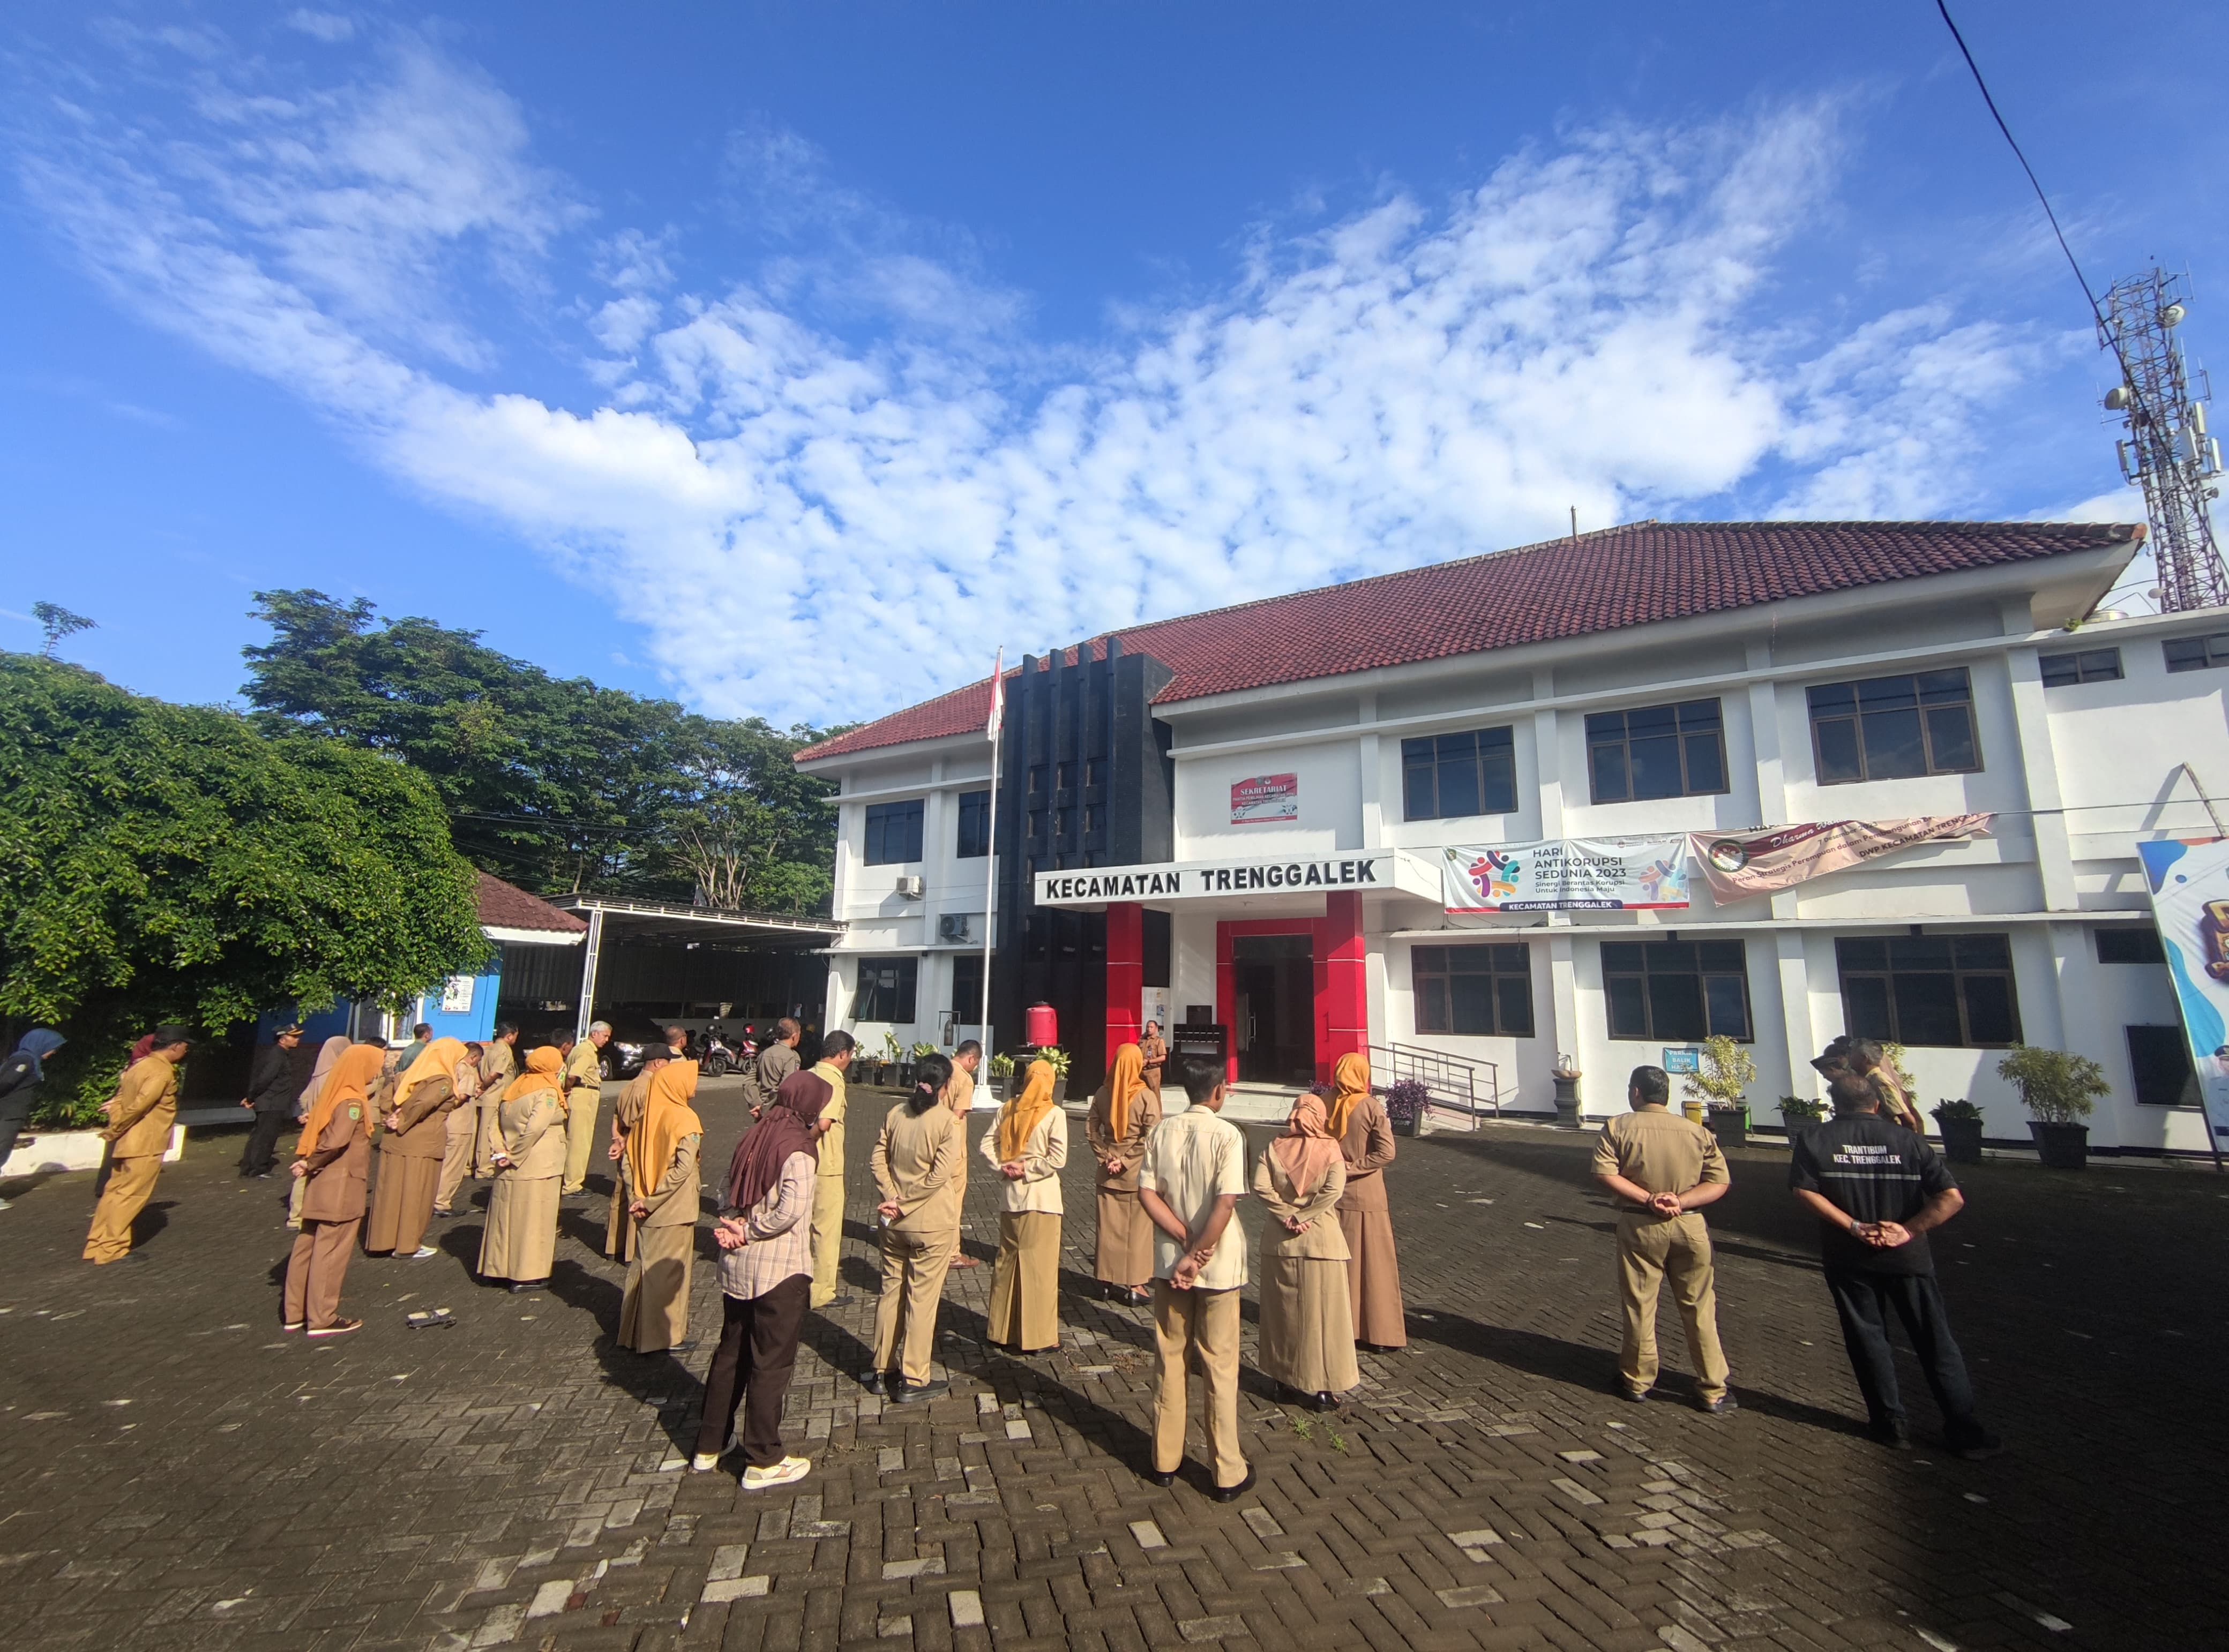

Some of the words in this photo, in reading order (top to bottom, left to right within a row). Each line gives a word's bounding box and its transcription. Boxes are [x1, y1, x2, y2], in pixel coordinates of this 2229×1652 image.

[1240, 785, 1286, 795] SEKRETARIAT
[1770, 828, 1814, 848] Dharma
[1824, 829, 1857, 843] Desember
[1860, 821, 1878, 831] 2023
[1859, 846, 1880, 858] DWP
[1881, 828, 1935, 850] KECAMATAN
[1533, 847, 1563, 858] HARI
[1732, 875, 1755, 883] Peran
[1756, 863, 1791, 879] Strategis
[1792, 847, 1836, 866] Perempuan
[1837, 839, 1863, 850] dalam
[1863, 820, 1922, 842] Pembangunan
[1534, 857, 1622, 869] ANTIKORUPSI
[1046, 872, 1181, 899] KECAMATAN
[1201, 859, 1377, 891] TRENGGALEK
[1535, 869, 1592, 880] SEDUNIA
[1596, 868, 1626, 877] 2023
[1509, 902, 1557, 911] KECAMATAN
[1559, 901, 1612, 909] TRENGGALEK
[1842, 1145, 1887, 1154] TRANTIBUM
[1833, 1154, 1851, 1163] KEC.
[1851, 1154, 1902, 1164] TRENGGALEK
